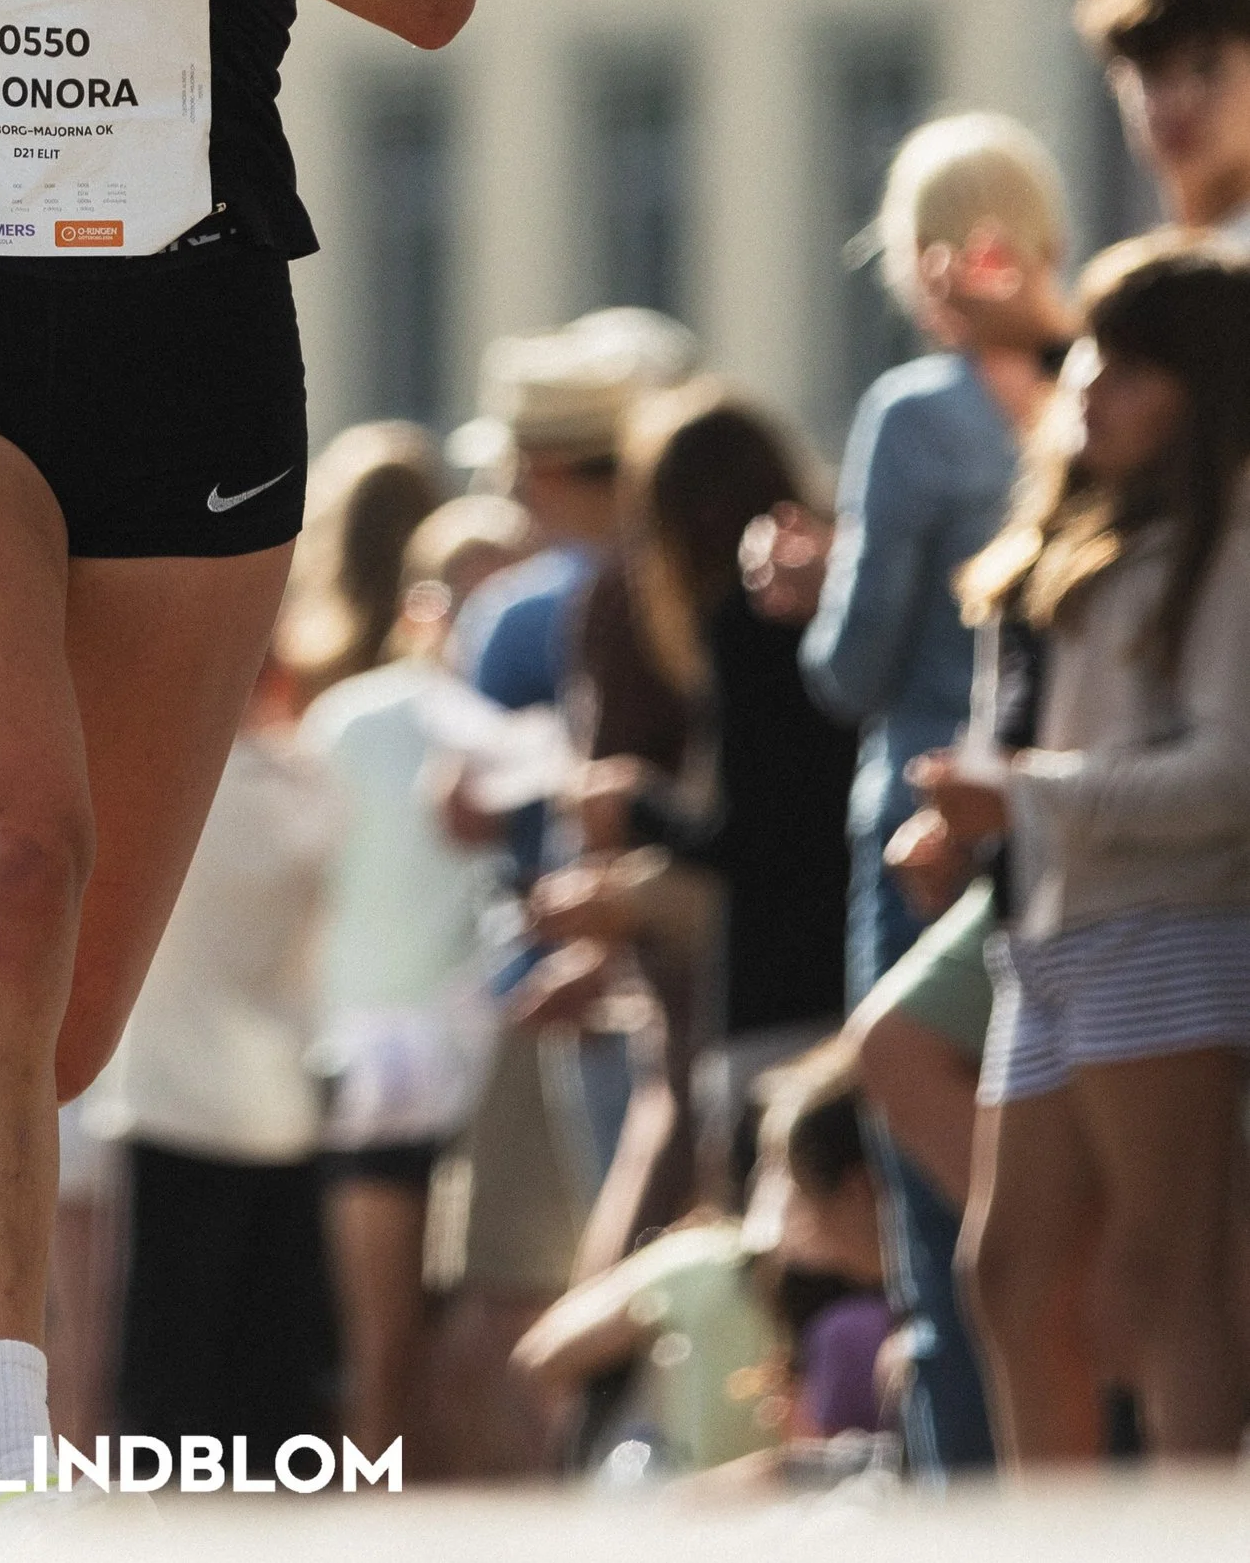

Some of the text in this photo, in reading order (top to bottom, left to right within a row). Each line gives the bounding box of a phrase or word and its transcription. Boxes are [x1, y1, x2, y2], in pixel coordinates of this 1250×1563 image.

[95, 124, 114, 135] OK
[14, 147, 61, 159] D21 ELIT
